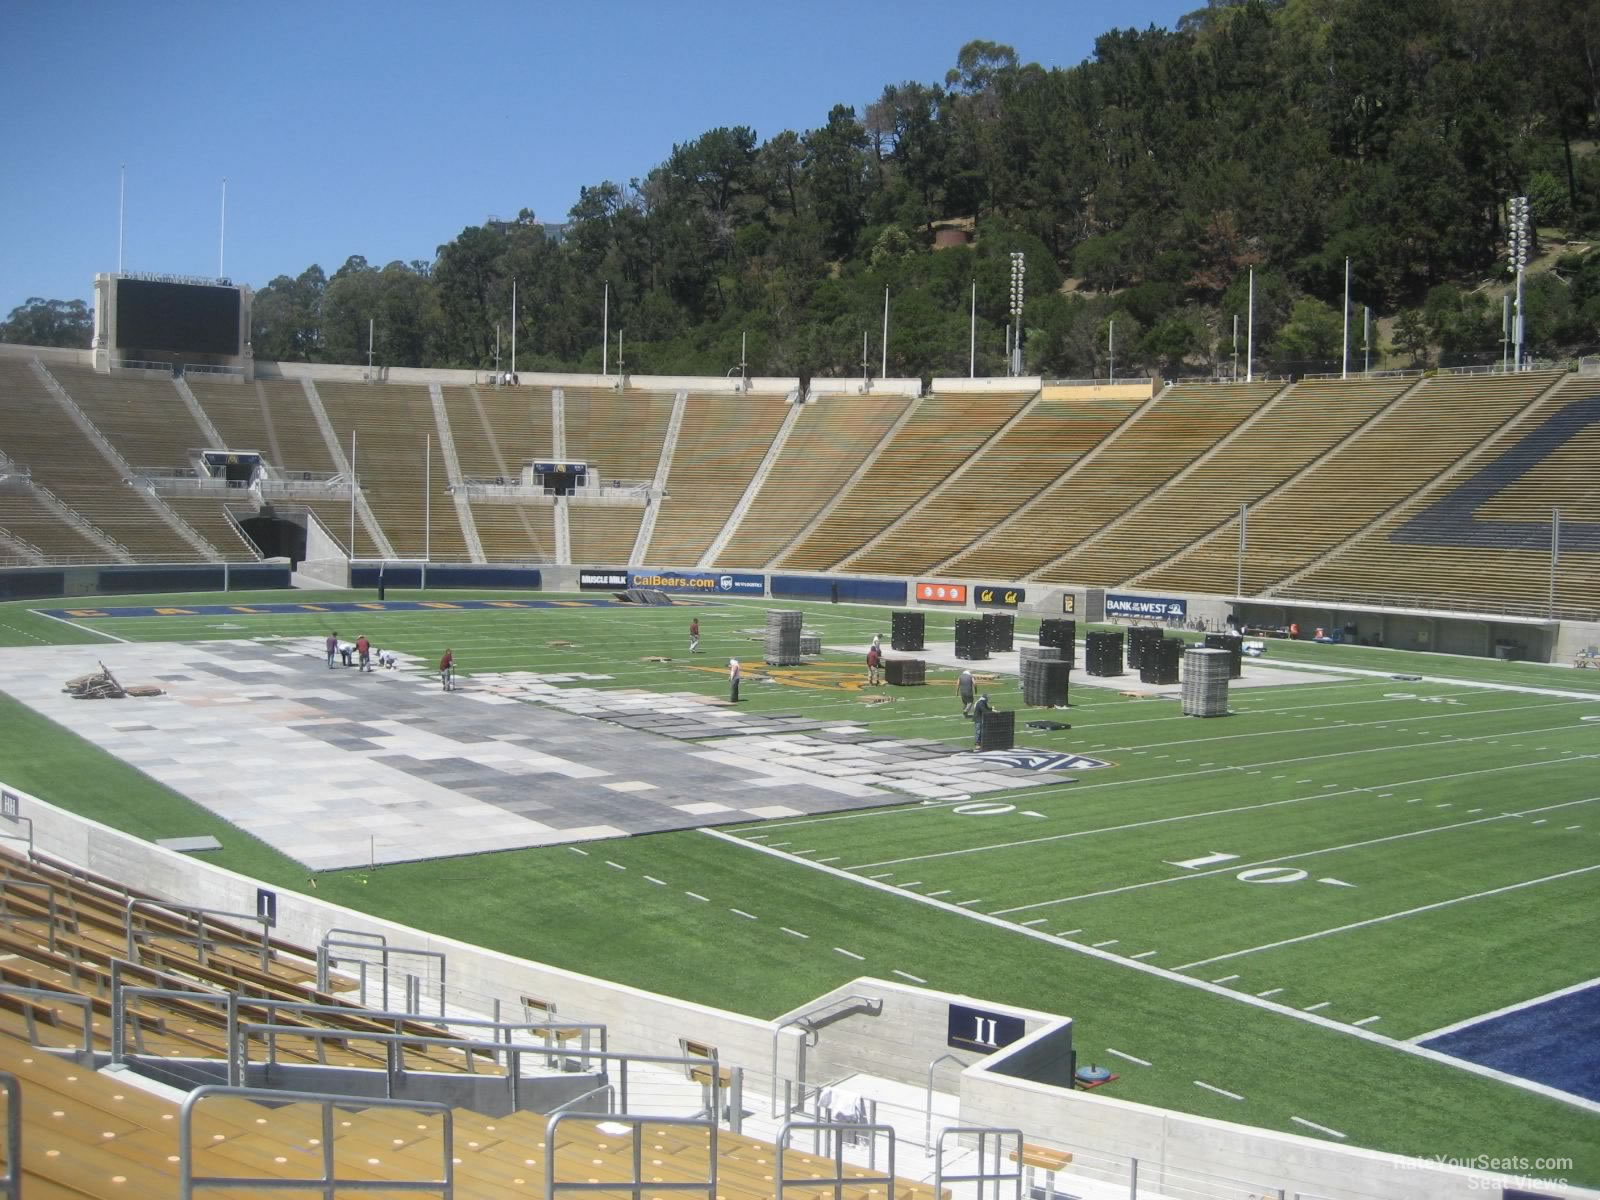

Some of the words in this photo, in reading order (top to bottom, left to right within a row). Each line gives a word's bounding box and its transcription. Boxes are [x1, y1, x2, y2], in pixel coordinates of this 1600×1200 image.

[581, 575, 608, 584] MUSCLE
[608, 575, 627, 584] MILK
[633, 575, 715, 588] CalBears.com
[981, 589, 994, 602] Cal
[1005, 591, 1018, 603] Cal
[1065, 600, 1073, 612] 12
[1107, 600, 1132, 611] BANK
[1140, 602, 1167, 614] WEST
